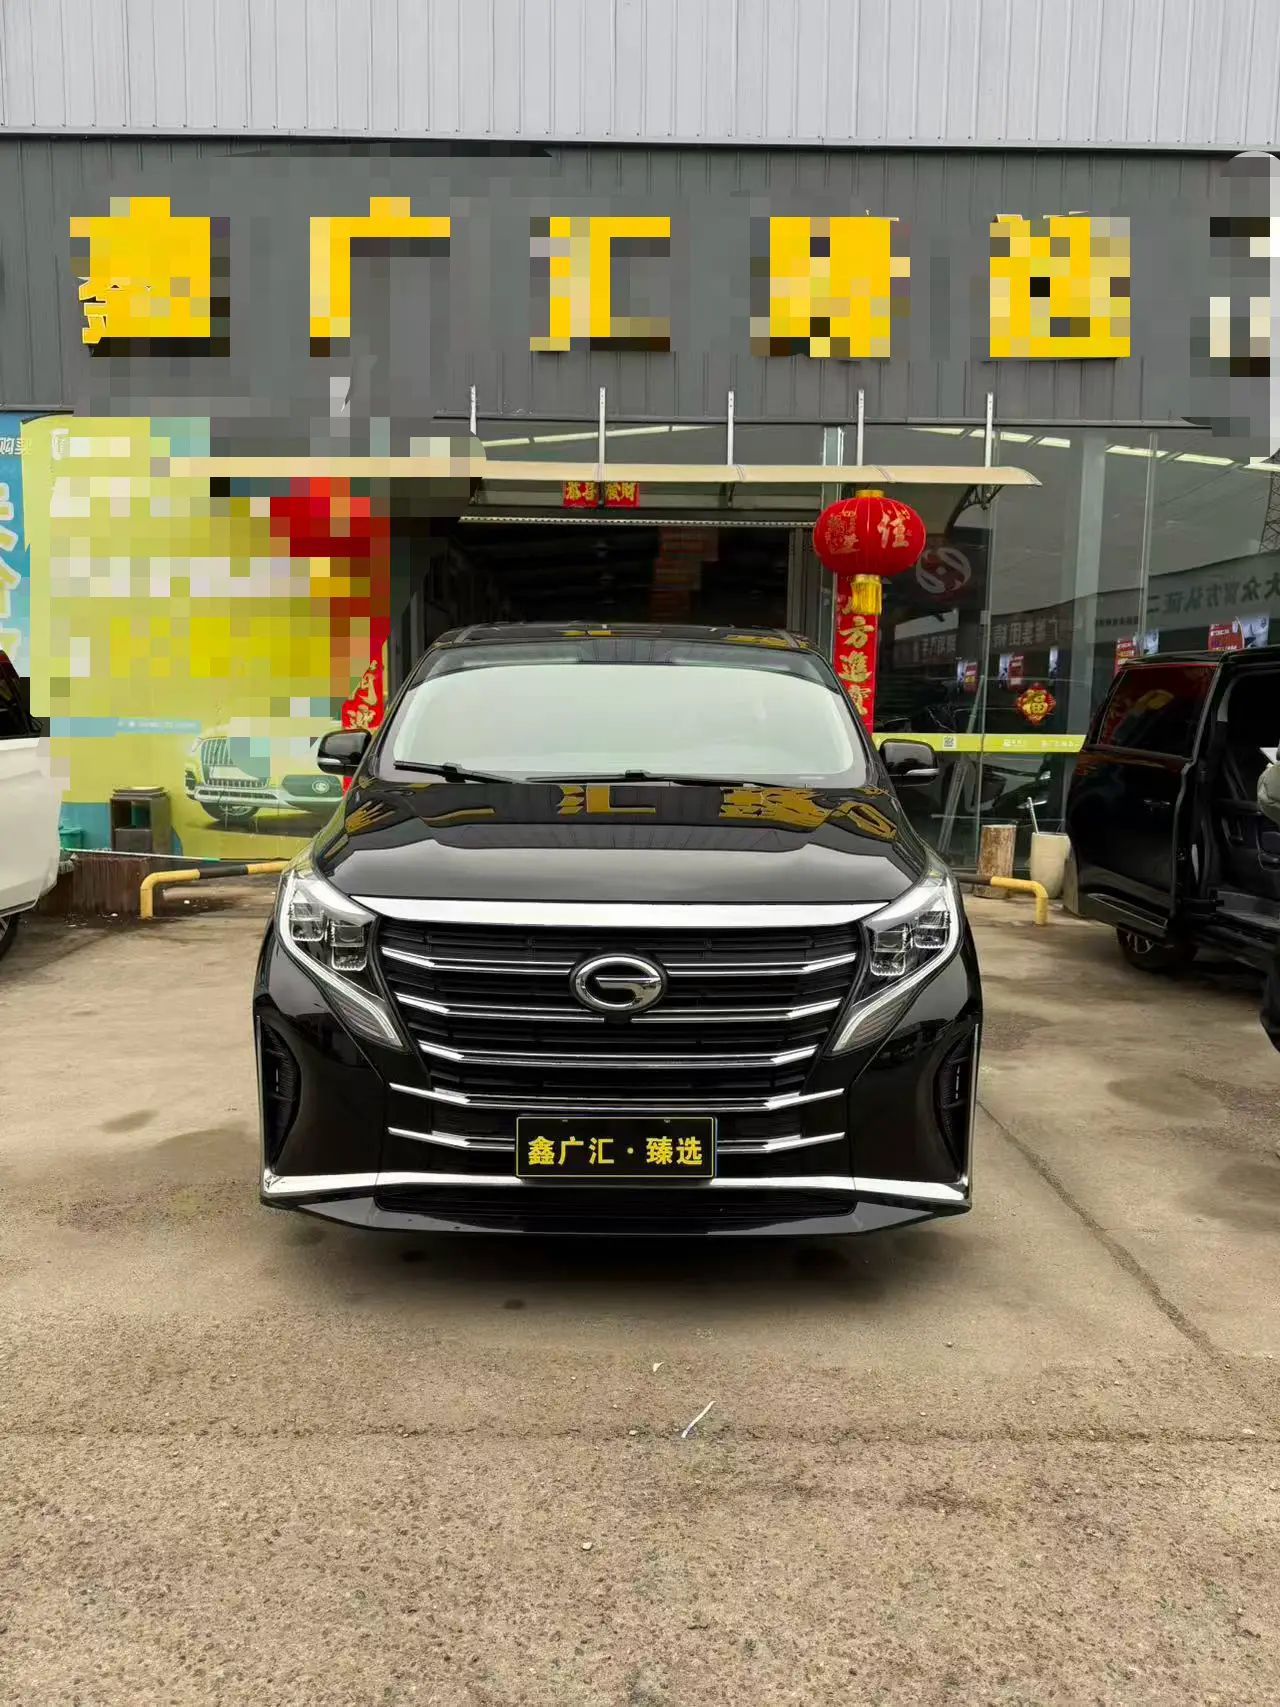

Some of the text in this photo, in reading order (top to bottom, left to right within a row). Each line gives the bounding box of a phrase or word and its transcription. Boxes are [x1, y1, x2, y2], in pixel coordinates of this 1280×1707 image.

[528, 1136, 702, 1165] 鑫广汇·臻选
